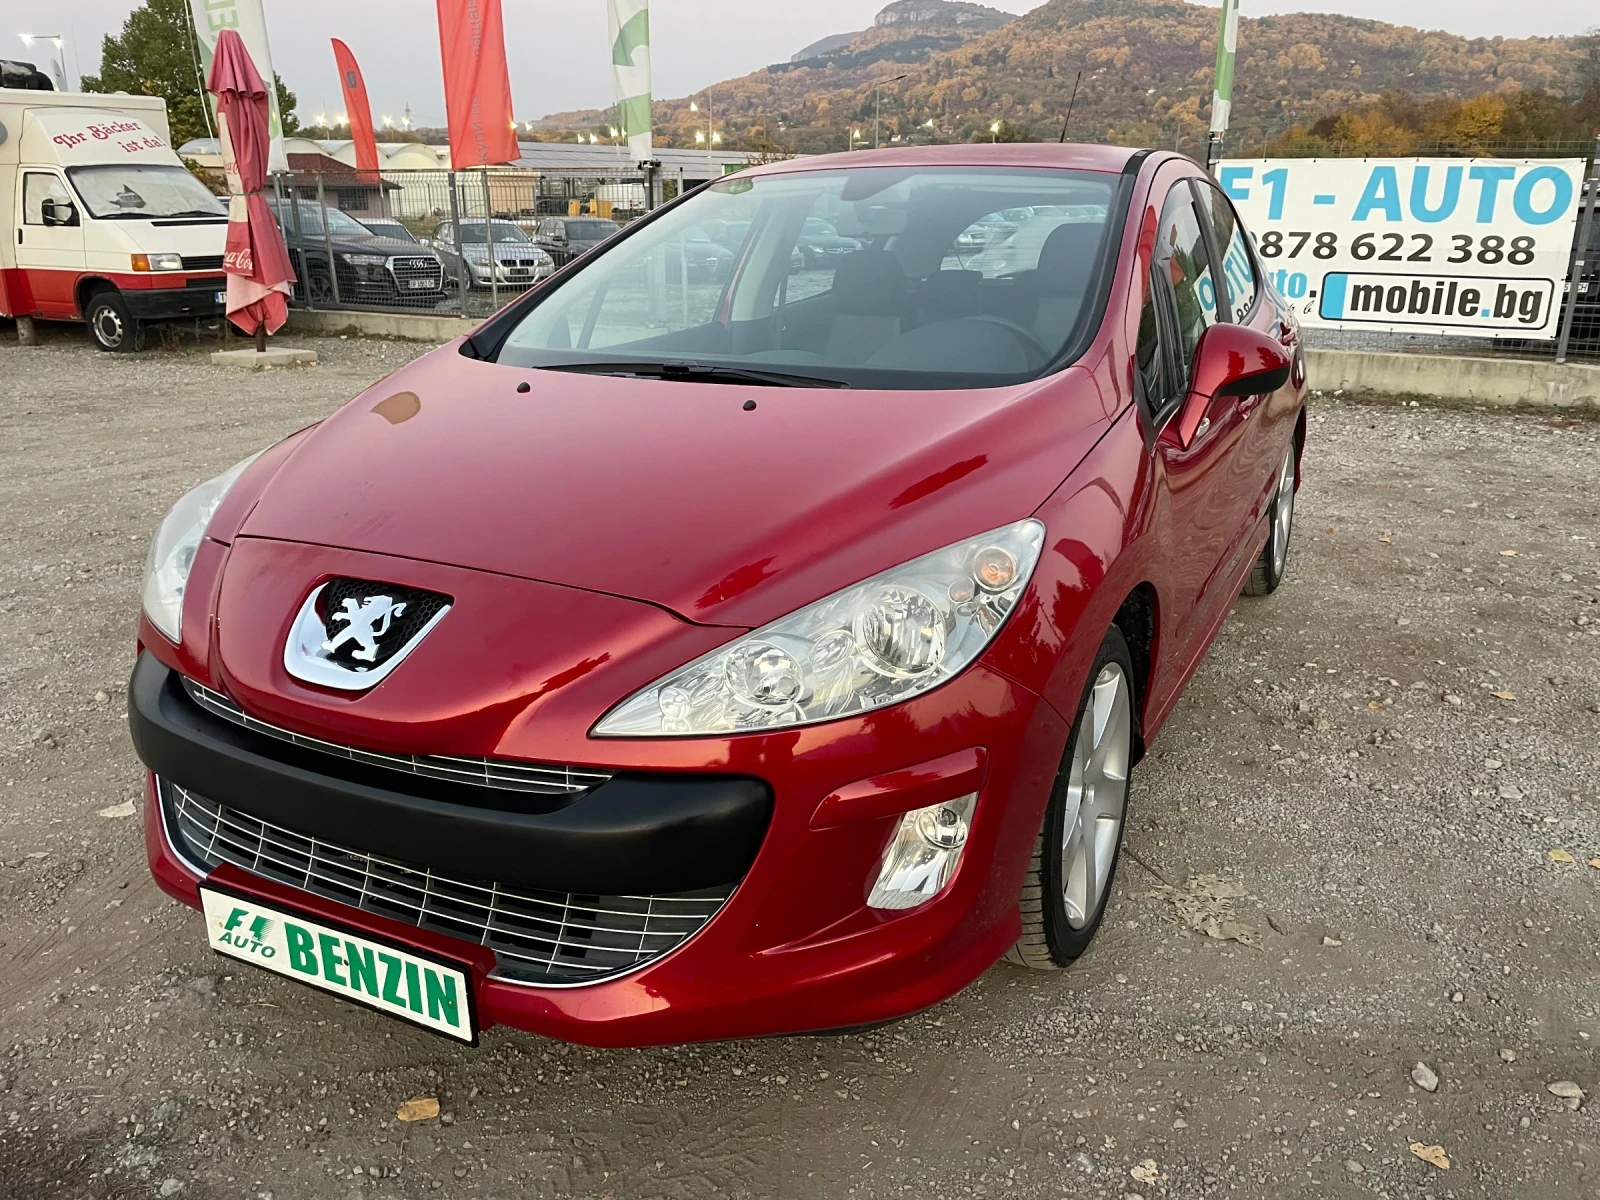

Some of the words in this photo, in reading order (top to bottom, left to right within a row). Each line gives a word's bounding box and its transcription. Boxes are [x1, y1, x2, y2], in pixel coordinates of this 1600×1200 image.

[86, 121, 141, 140] Bäcker
[118, 139, 144, 153] ist
[143, 135, 167, 148] da!
[1219, 166, 1288, 221] F1
[1352, 165, 1574, 226] AUTO
[1250, 230, 1338, 260] 878
[1351, 232, 1434, 263] 622
[1447, 234, 1536, 266] 388
[1351, 280, 1543, 323] mobile.bg
[218, 931, 276, 959] AUTO
[284, 922, 460, 1028] BENZIN
